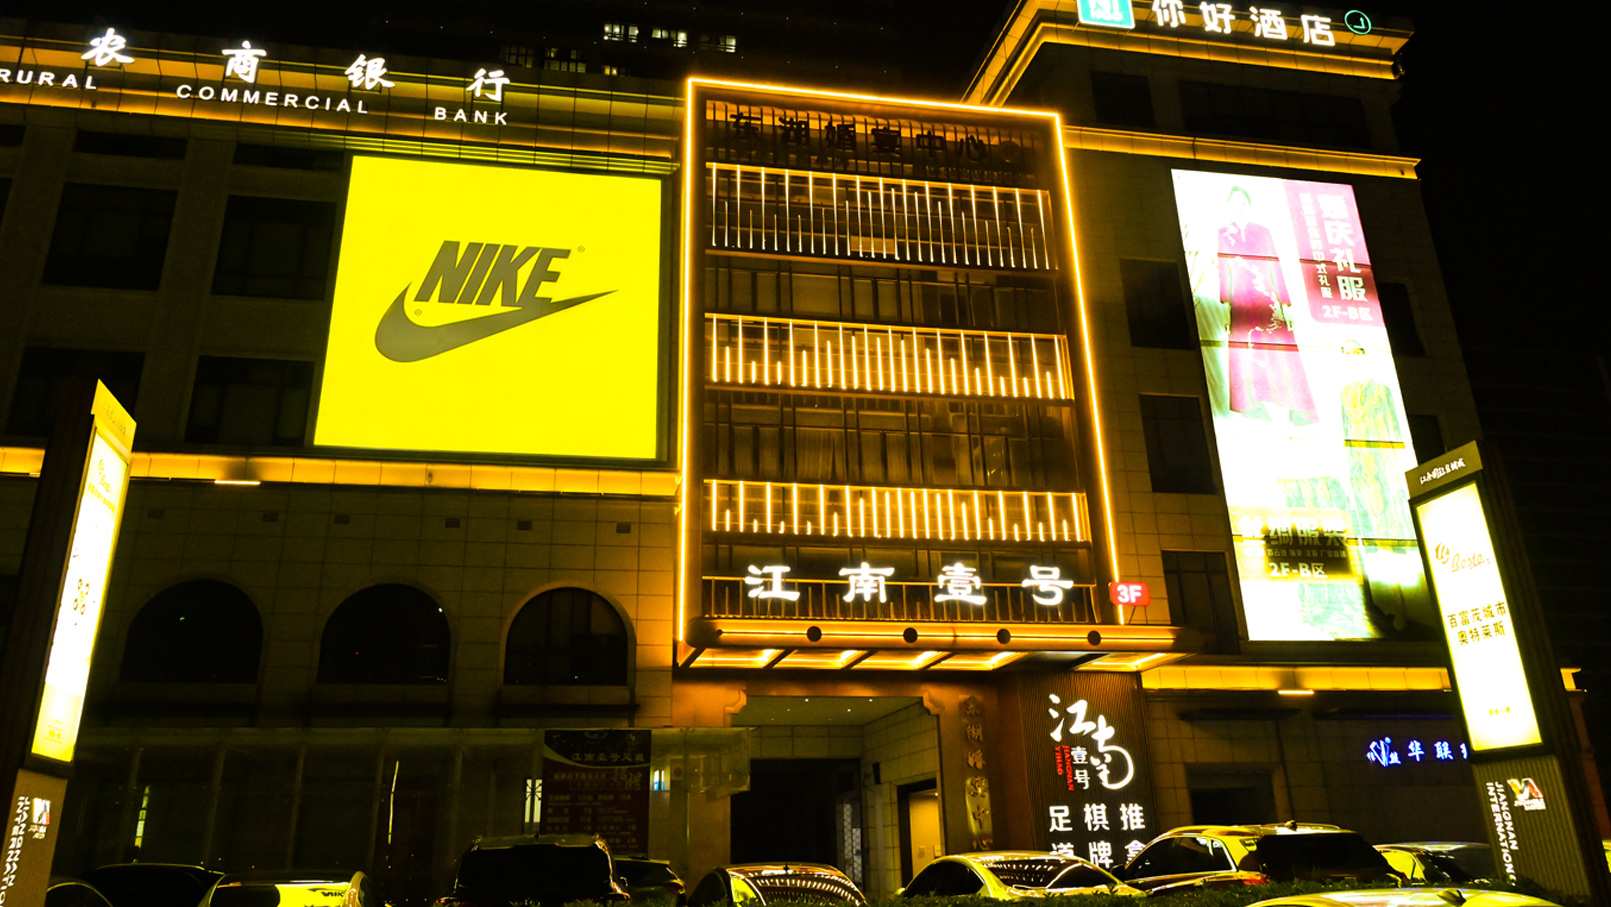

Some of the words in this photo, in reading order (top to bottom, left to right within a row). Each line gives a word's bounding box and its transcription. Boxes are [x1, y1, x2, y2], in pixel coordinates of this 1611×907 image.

[1152, 0, 1335, 47] 你好酒店
[81, 28, 511, 102] 农商银行
[0, 68, 98, 91] RURAL
[177, 84, 369, 114] COMMERCIAL
[434, 106, 508, 126] BANK
[413, 240, 571, 308] NIKE
[744, 562, 1074, 606] 江南壹号
[1116, 584, 1143, 602] 3F
[1269, 562, 1328, 578] 2F-B区
[1447, 601, 1506, 628] 百富茂城市
[1458, 621, 1506, 646] 奥特莱斯
[1061, 744, 1074, 791] JIANGNAN
[1071, 746, 1091, 790] 壹号
[1485, 781, 1517, 887] INTERNATION
[1494, 781, 1519, 851] JIANGNAN
